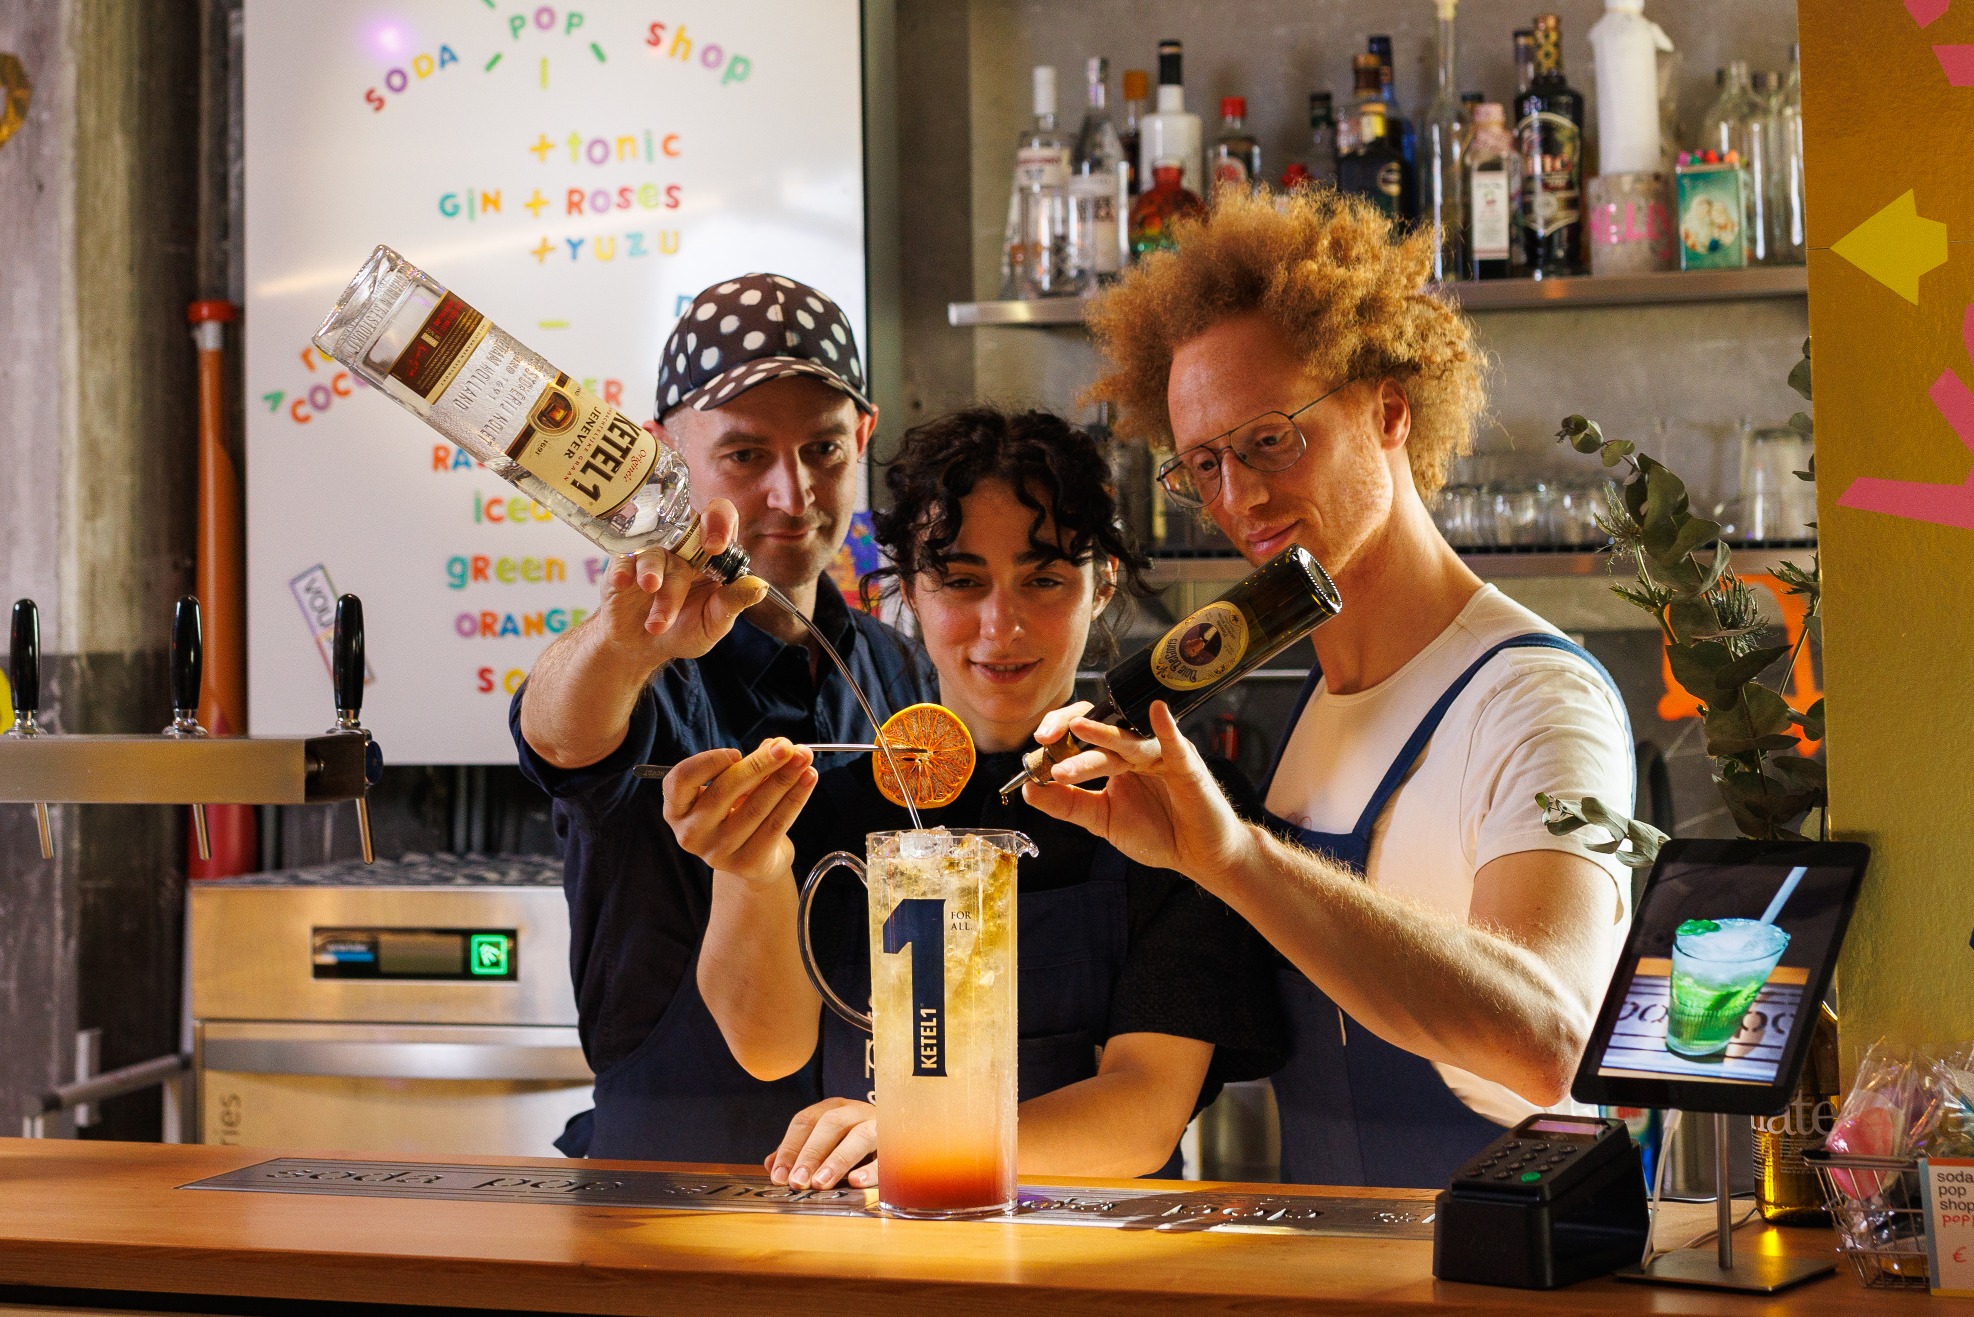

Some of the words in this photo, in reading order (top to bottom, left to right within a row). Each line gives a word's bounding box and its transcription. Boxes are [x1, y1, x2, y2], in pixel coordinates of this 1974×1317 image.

[364, 43, 458, 112] SODA
[509, 6, 584, 39] POP
[567, 130, 681, 165] tonic
[566, 230, 680, 261] YUZU
[289, 371, 368, 424] COC
[563, 406, 602, 460] JENEVER
[432, 444, 486, 472] RA
[534, 439, 549, 457] 1691
[562, 454, 584, 482] GRAAN
[951, 911, 972, 920] FOR
[883, 898, 947, 1077] 1
[266, 1168, 445, 1184] soda
[471, 1177, 623, 1194] pop
[1938, 1185, 1967, 1198] pop
